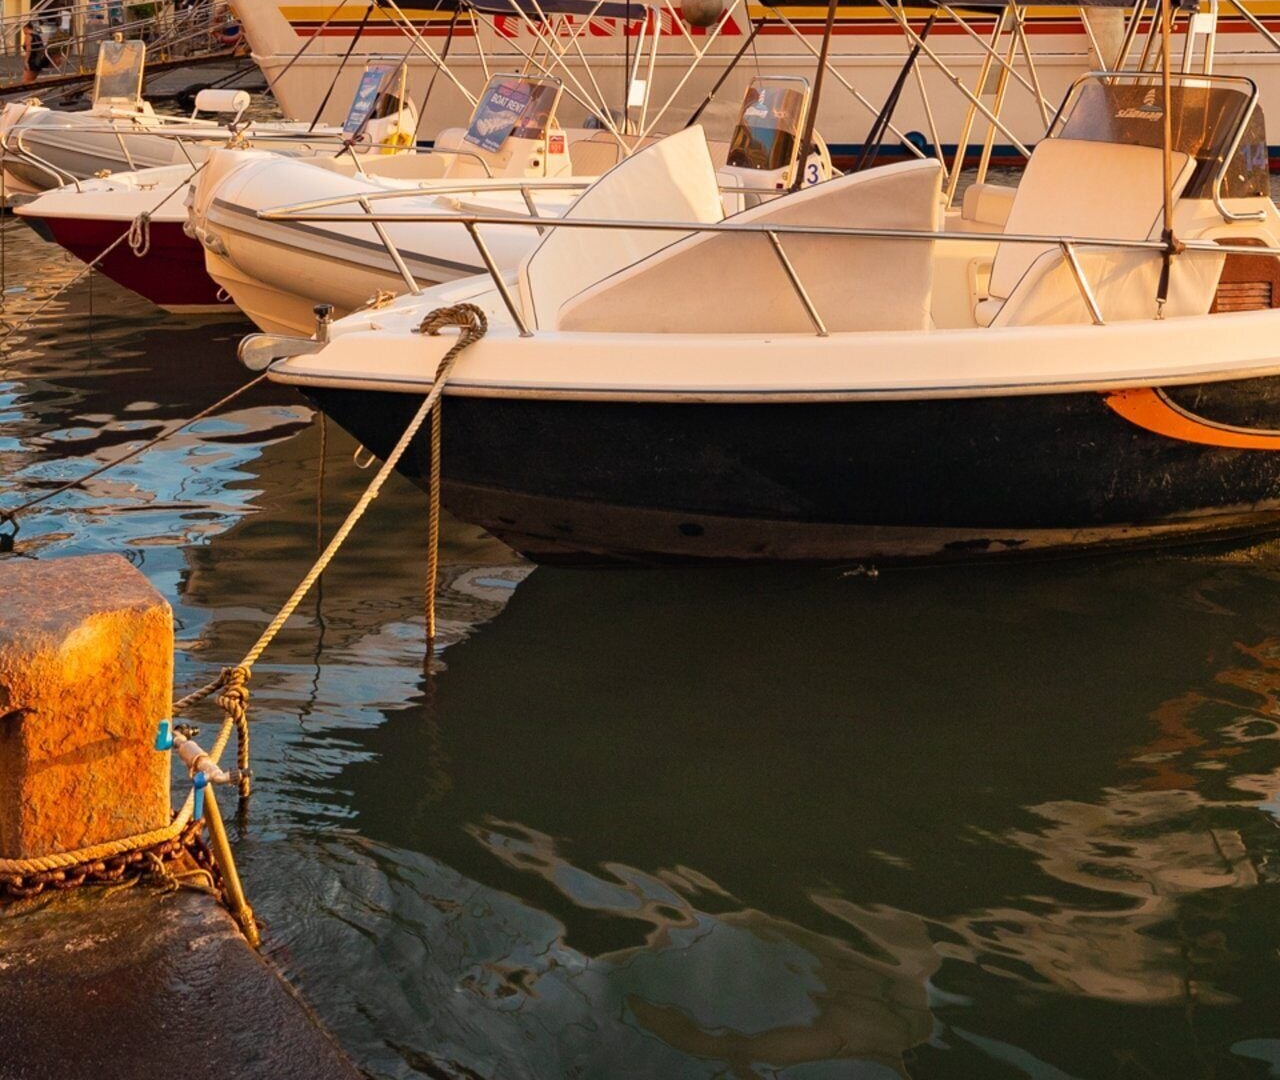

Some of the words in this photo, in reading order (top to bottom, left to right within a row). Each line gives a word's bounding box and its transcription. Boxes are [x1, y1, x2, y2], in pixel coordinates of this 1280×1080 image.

[490, 93, 510, 107] BOAT
[507, 98, 526, 113] RENT
[806, 163, 819, 185] 3
